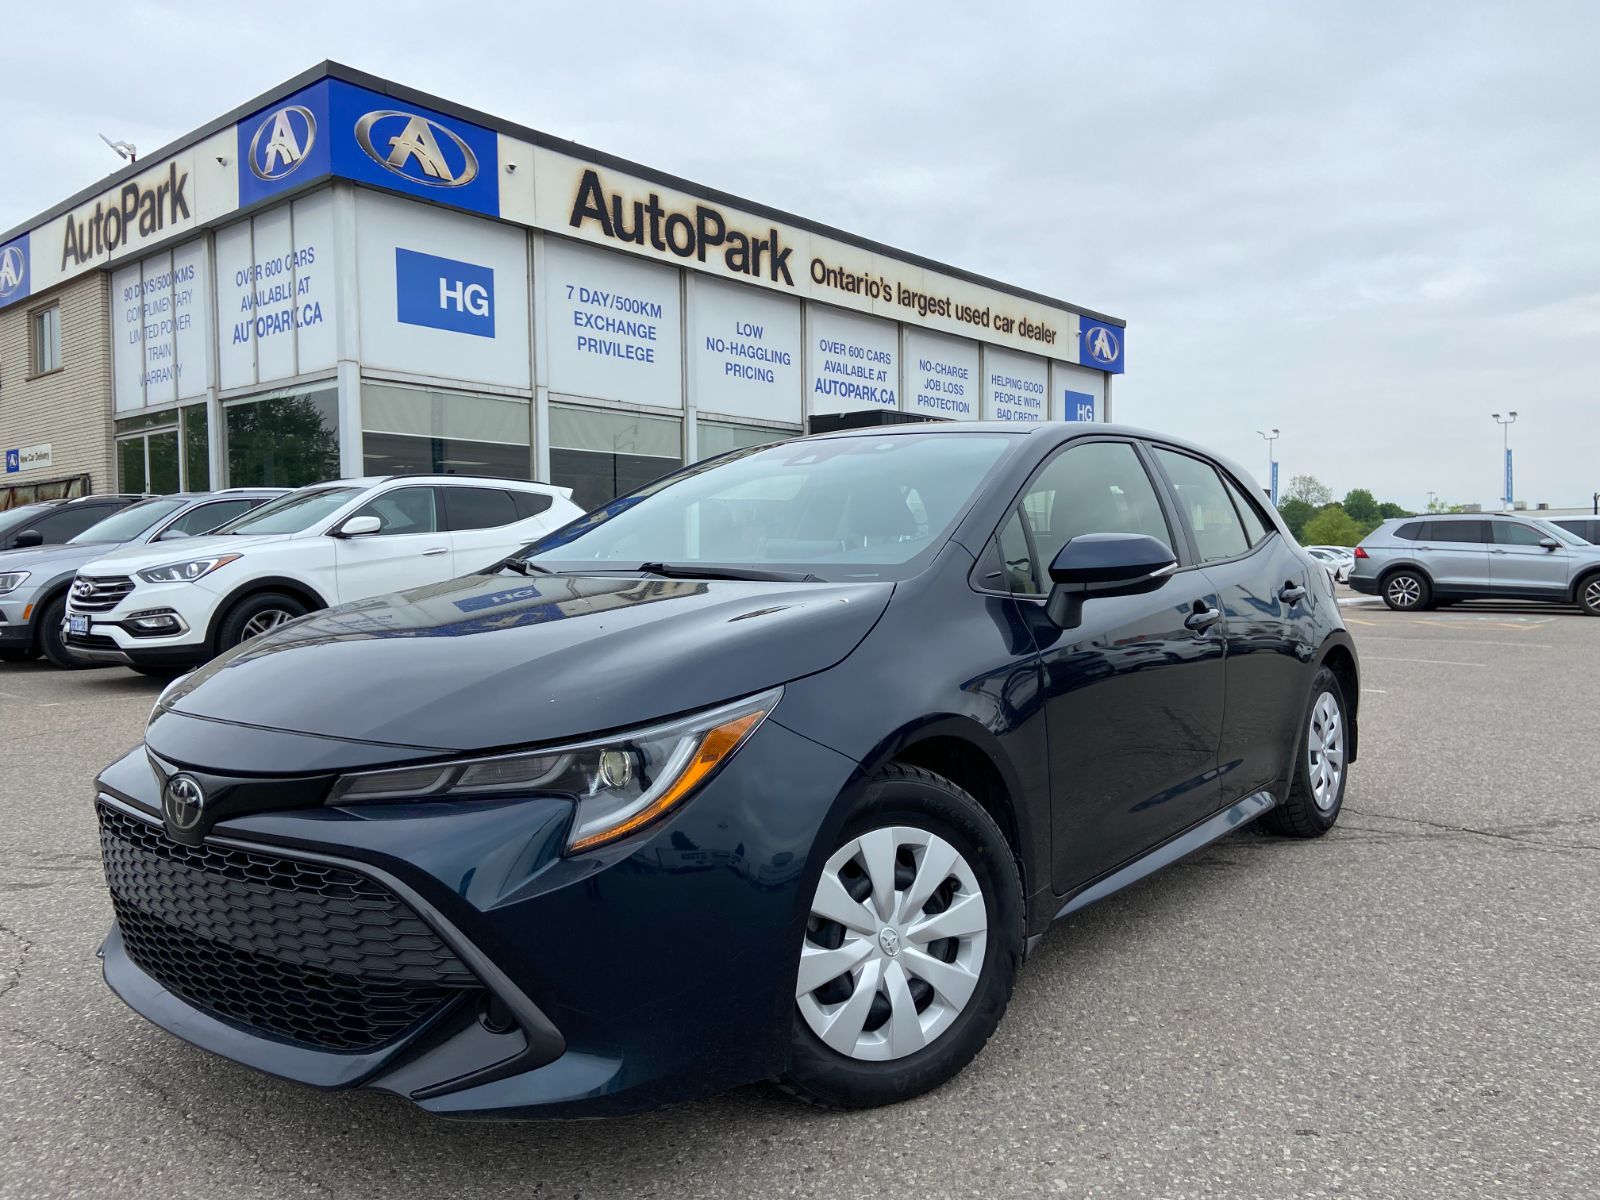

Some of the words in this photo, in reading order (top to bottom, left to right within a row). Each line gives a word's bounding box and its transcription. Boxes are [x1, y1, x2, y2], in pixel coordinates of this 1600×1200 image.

[61, 161, 190, 272] AutoPark
[569, 169, 794, 287] AutoPark
[265, 257, 283, 278] 600
[285, 246, 315, 271] CARS
[124, 286, 133, 302] 90
[297, 275, 311, 296] AT
[439, 276, 490, 318] HG
[127, 288, 193, 323] COPLIMENARY
[566, 284, 575, 300] 7
[579, 287, 662, 319] DAY/500KM
[810, 258, 892, 302] Ontario's
[897, 282, 952, 318] largest
[955, 304, 990, 328] used
[993, 314, 1016, 334] car
[1018, 317, 1057, 344] dealer
[130, 323, 159, 344] LIMTED
[574, 310, 657, 341] EXCHANGE
[736, 321, 764, 340] LOW
[147, 342, 172, 361] TRAIN
[577, 335, 655, 363] PRIVILEGE
[706, 336, 791, 366] NO-HAGGLING
[820, 339, 846, 356] OVER
[848, 345, 865, 360] 600
[866, 349, 892, 365] CARS
[139, 362, 183, 388] ARRANY
[725, 362, 774, 384] PRICING
[824, 359, 875, 380] AVAILABLE
[876, 370, 888, 383] AT
[919, 359, 969, 380] NO-CHARGE
[815, 377, 896, 406] AUTOPARK.CA
[924, 377, 941, 391] JOB
[942, 382, 964, 396] LOSS
[991, 374, 1022, 390] HELPING
[1023, 381, 1044, 395] GOOD
[917, 394, 970, 414] PROTECTION
[994, 391, 1022, 406] PEOPLE
[1023, 396, 1041, 409] WITH
[1076, 402, 1093, 421] HG
[997, 408, 1012, 420] BAD
